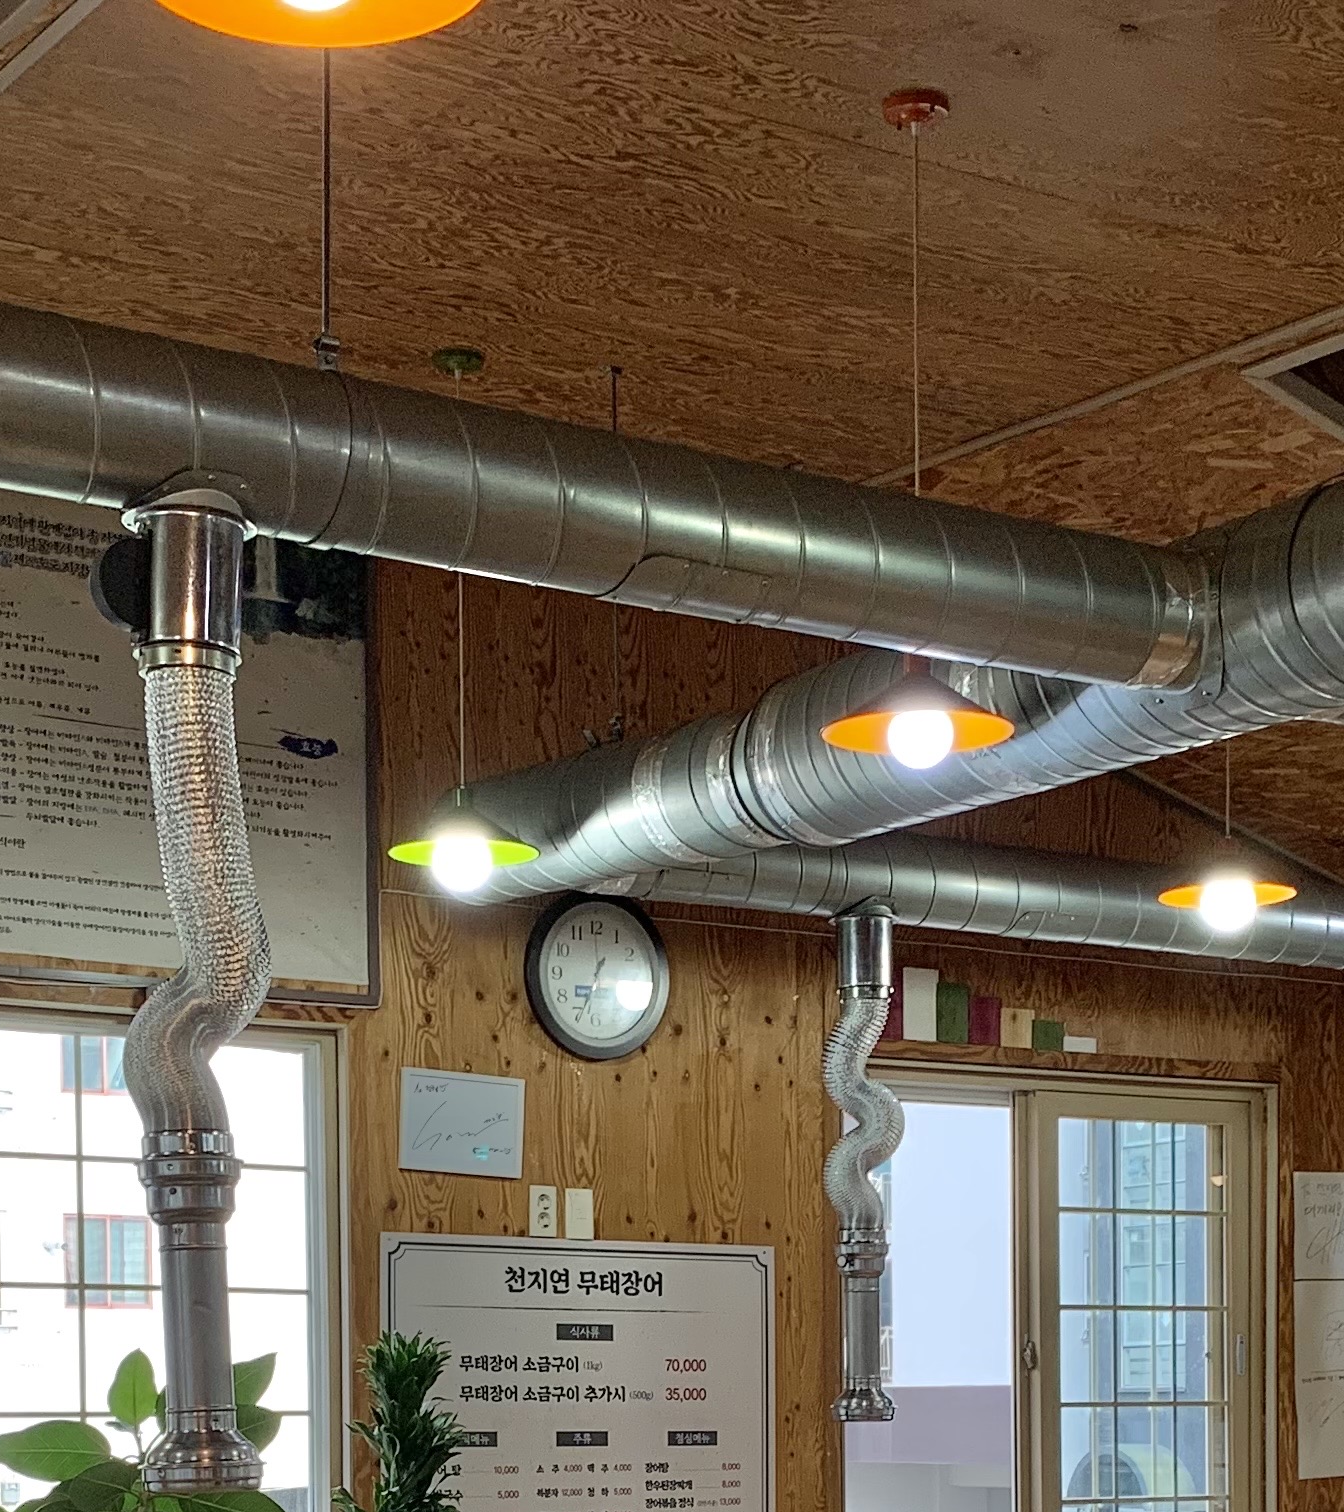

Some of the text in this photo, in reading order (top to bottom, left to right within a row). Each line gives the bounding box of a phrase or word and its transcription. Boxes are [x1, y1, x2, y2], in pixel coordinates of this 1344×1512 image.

[571, 925, 582, 940] 11
[591, 921, 603, 935] 12
[557, 942, 570, 957] 10
[624, 947, 635, 961] 2
[552, 966, 563, 980] 9
[557, 989, 568, 1003] 8
[505, 1266, 663, 1296] 천지연 무태장어
[570, 1326, 600, 1340] 식사류
[459, 1354, 707, 1374] 무태장어 소금구이 (1kg) 70,000
[459, 1384, 707, 1403] 무태장어 소금구이 추가시 (500g) 35,000
[572, 1432, 592, 1445] 주류
[675, 1432, 711, 1445] 점심메뉴
[494, 1466, 520, 1476] 10,000
[563, 1463, 583, 1473] 4,000
[613, 1463, 633, 1473] 4,000
[721, 1462, 742, 1472] 8,000
[721, 1479, 742, 1489] 8,000
[497, 1490, 520, 1500] 5,000
[536, 1488, 560, 1498] 복분자
[613, 1487, 633, 1497] 5,000
